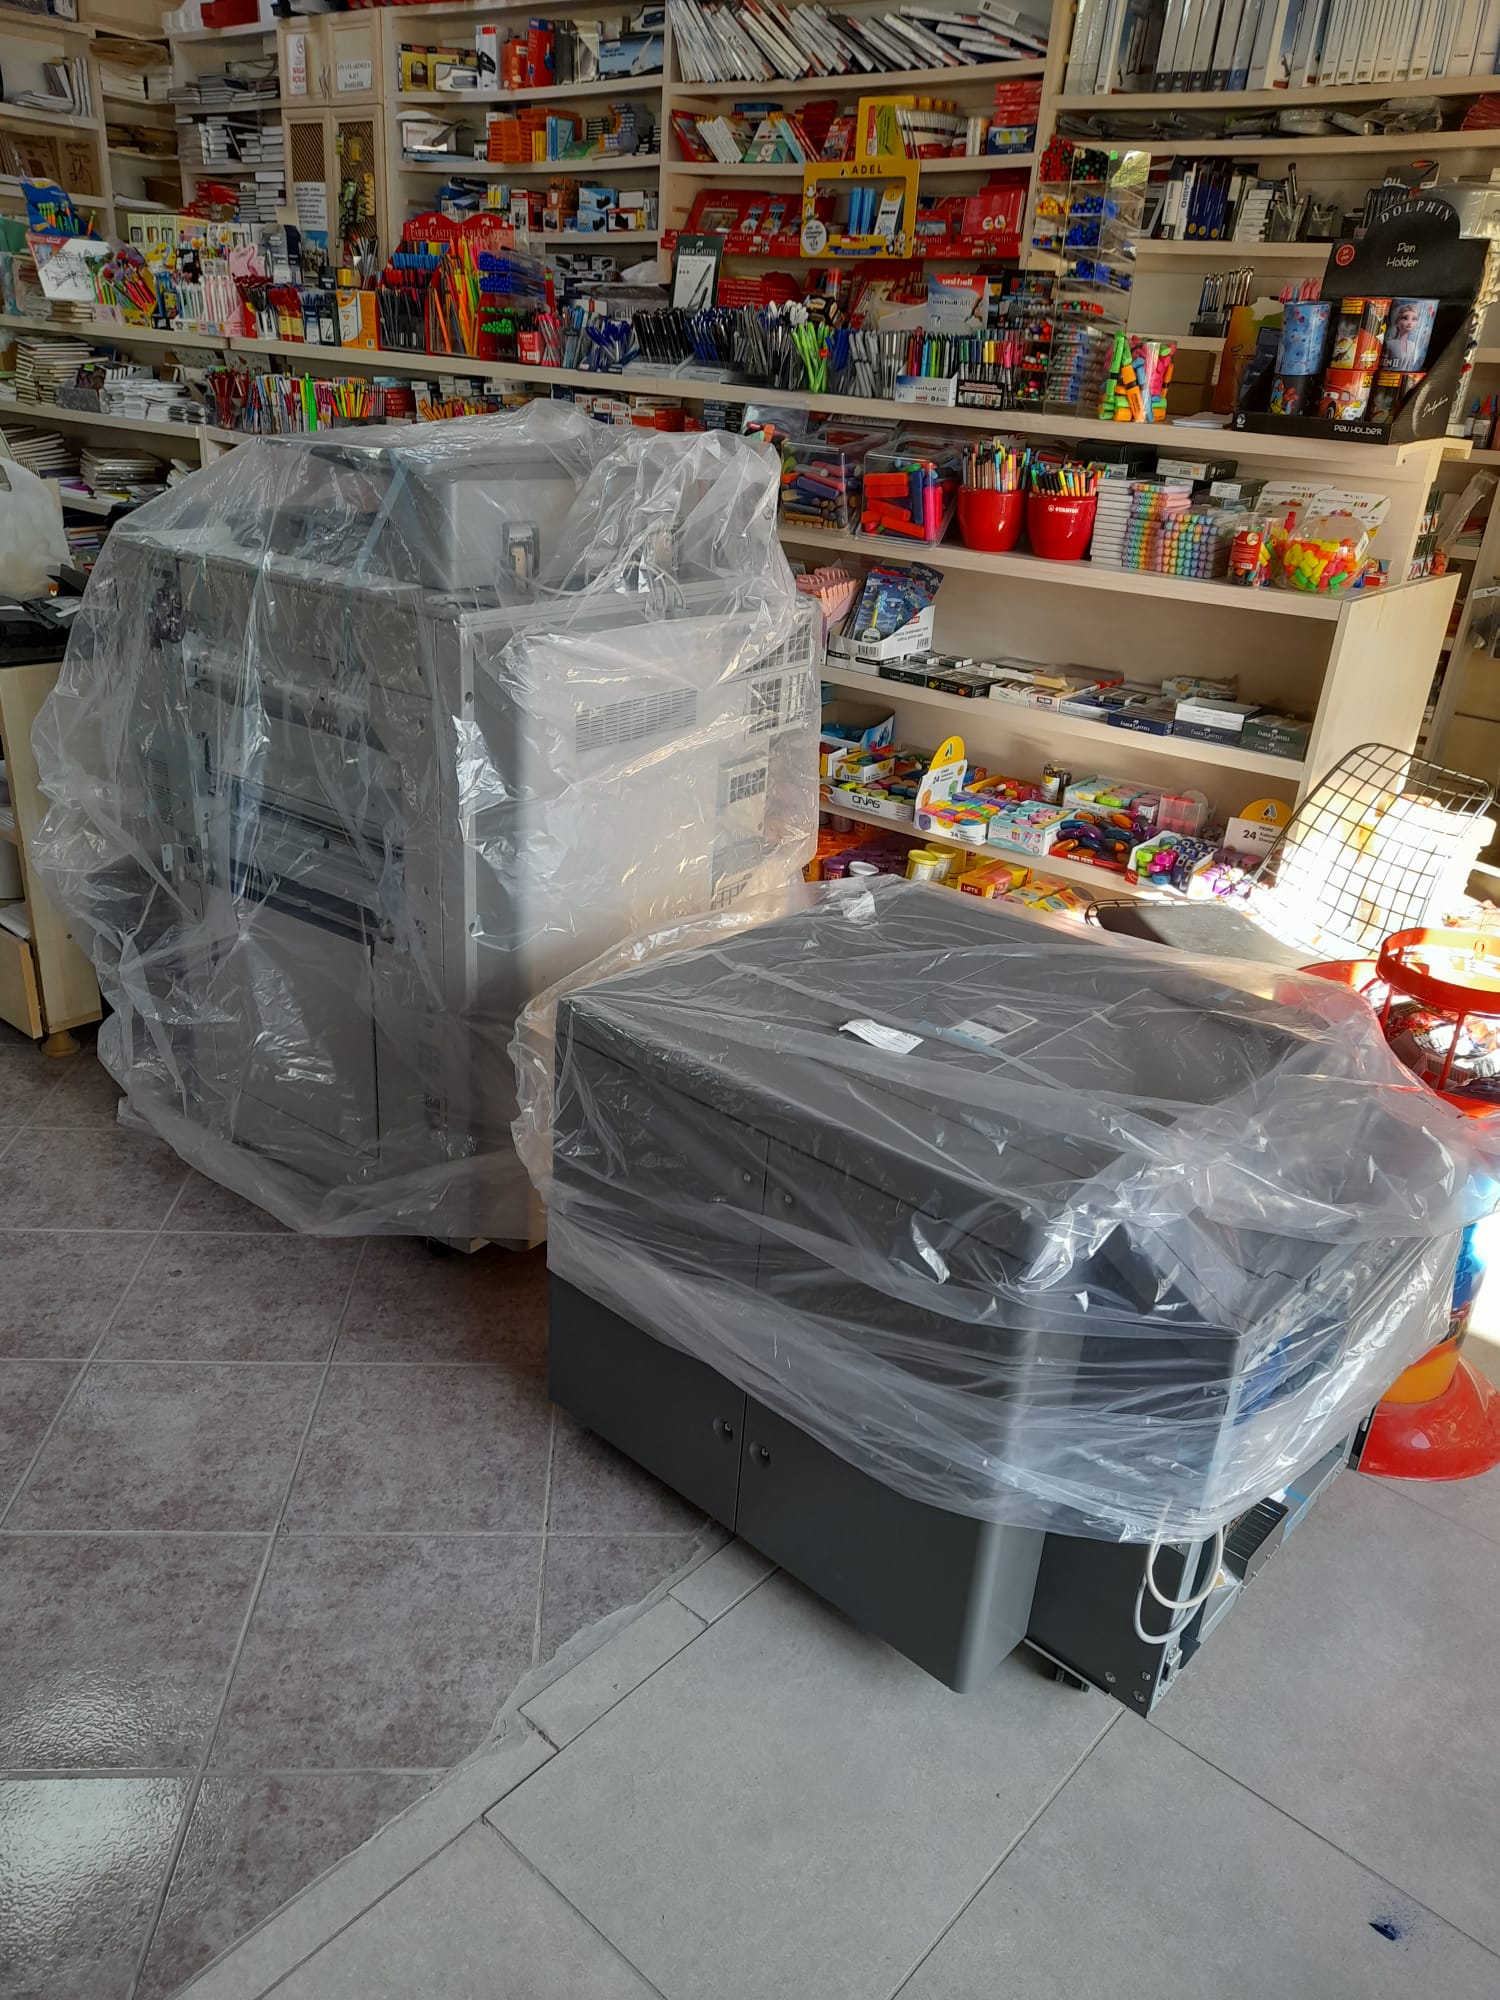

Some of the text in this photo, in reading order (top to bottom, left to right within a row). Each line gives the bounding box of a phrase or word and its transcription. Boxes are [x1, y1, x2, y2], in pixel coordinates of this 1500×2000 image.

[851, 164, 883, 175] ADEL
[1181, 175, 1192, 208] CASIO
[1380, 200, 1453, 224] DOLPHIN
[1396, 242, 1416, 253] Pen
[1386, 255, 1419, 268] Holder
[1242, 829, 1257, 840] 24
